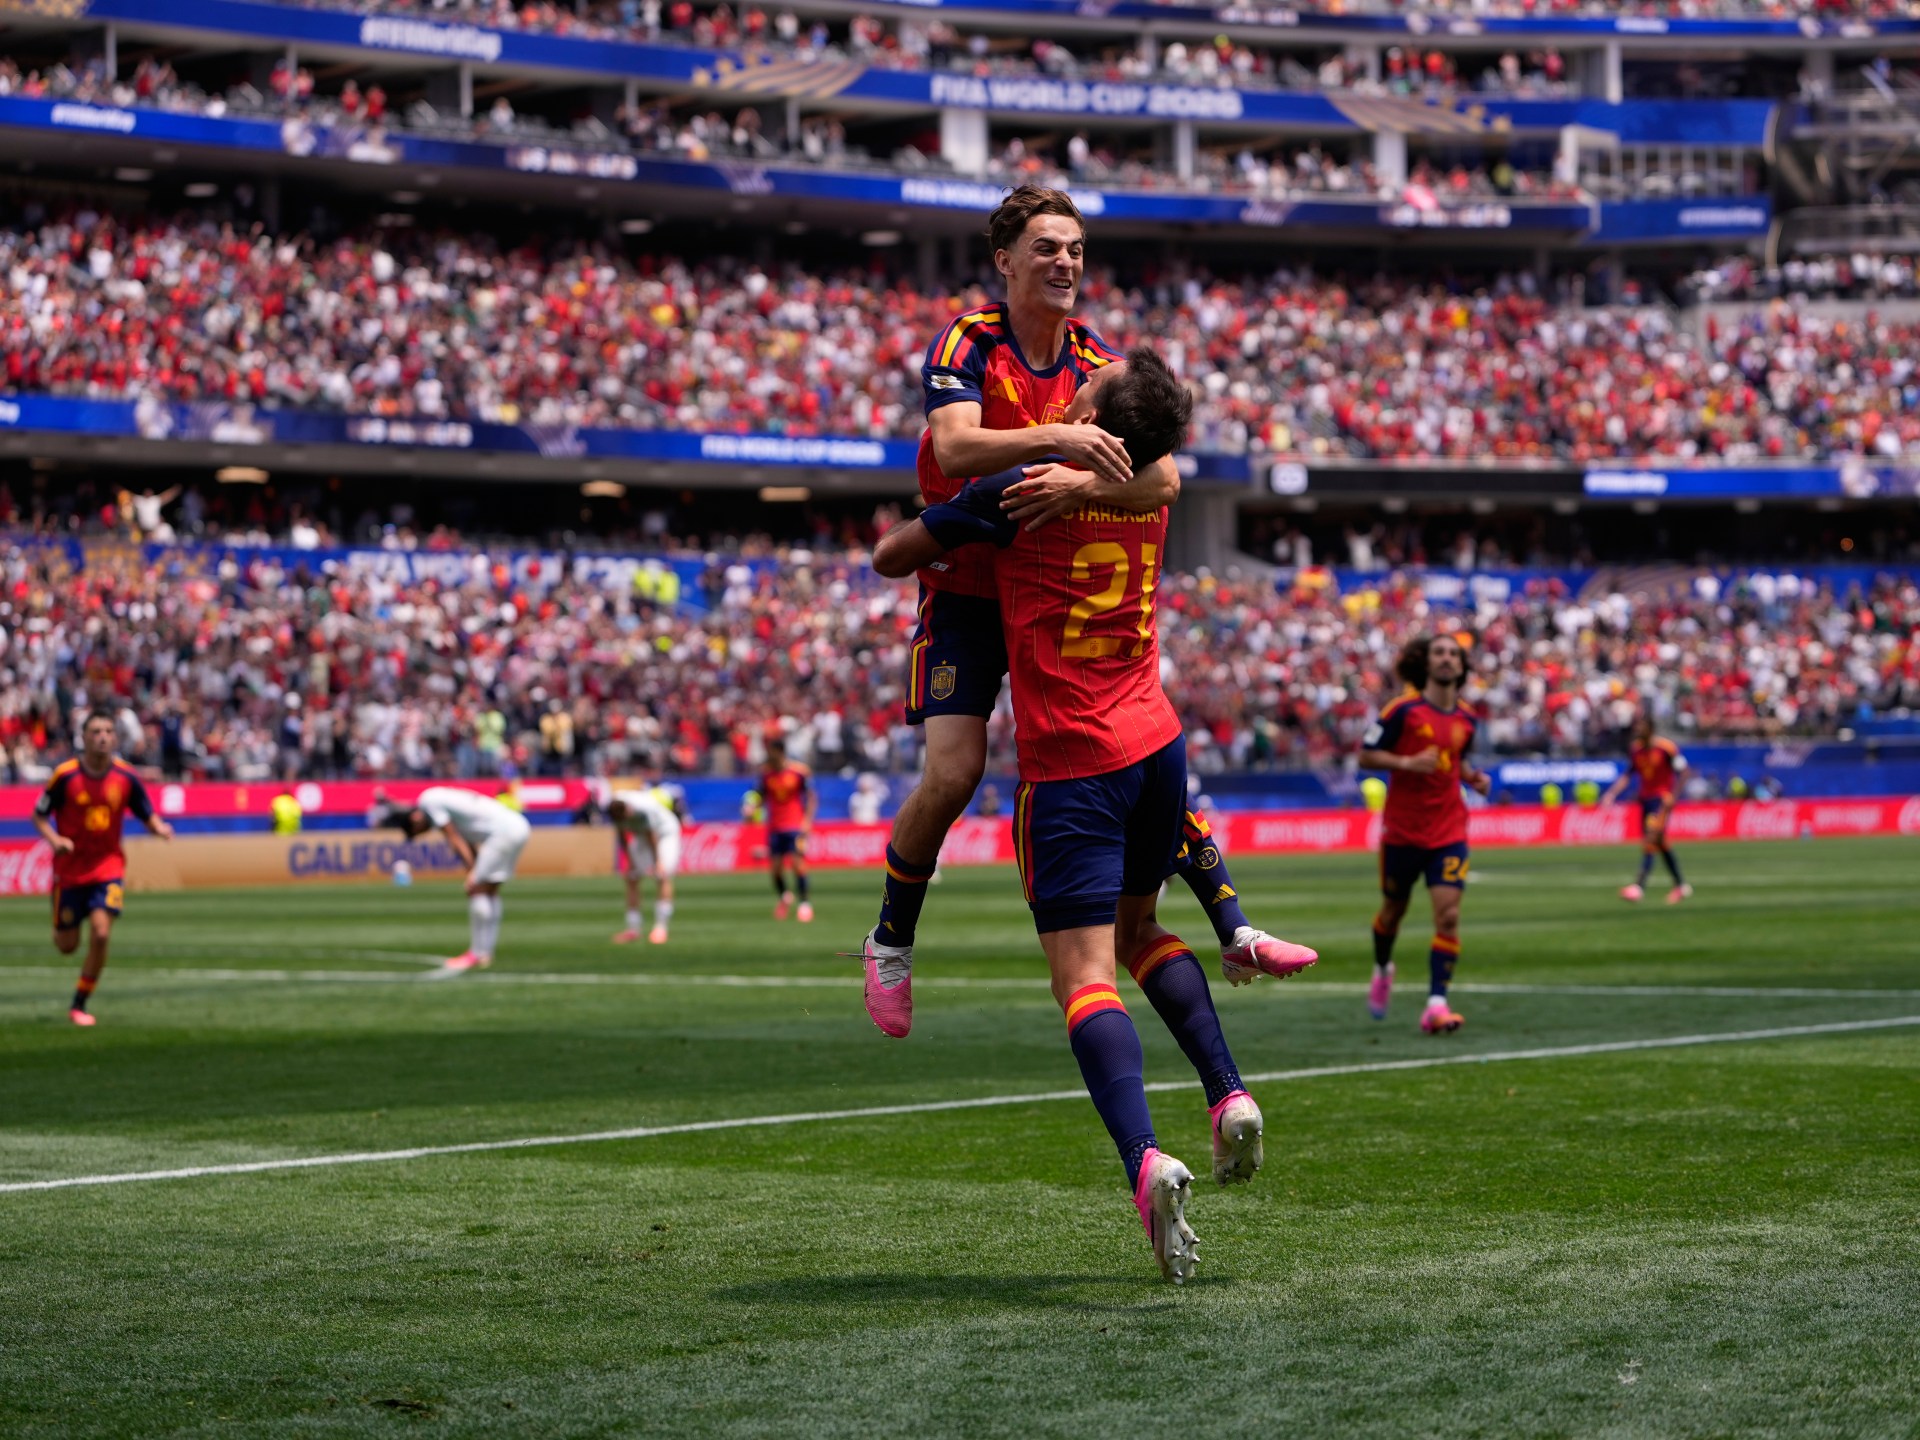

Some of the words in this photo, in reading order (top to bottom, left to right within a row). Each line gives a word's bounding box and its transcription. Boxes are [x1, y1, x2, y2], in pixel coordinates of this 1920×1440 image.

[931, 75, 988, 105] FIFA
[989, 79, 1088, 112] WORLD
[1090, 84, 1145, 113] CUP
[1147, 85, 1243, 119] 2026
[1060, 500, 1161, 524] YARZAA
[1061, 542, 1158, 658] 21
